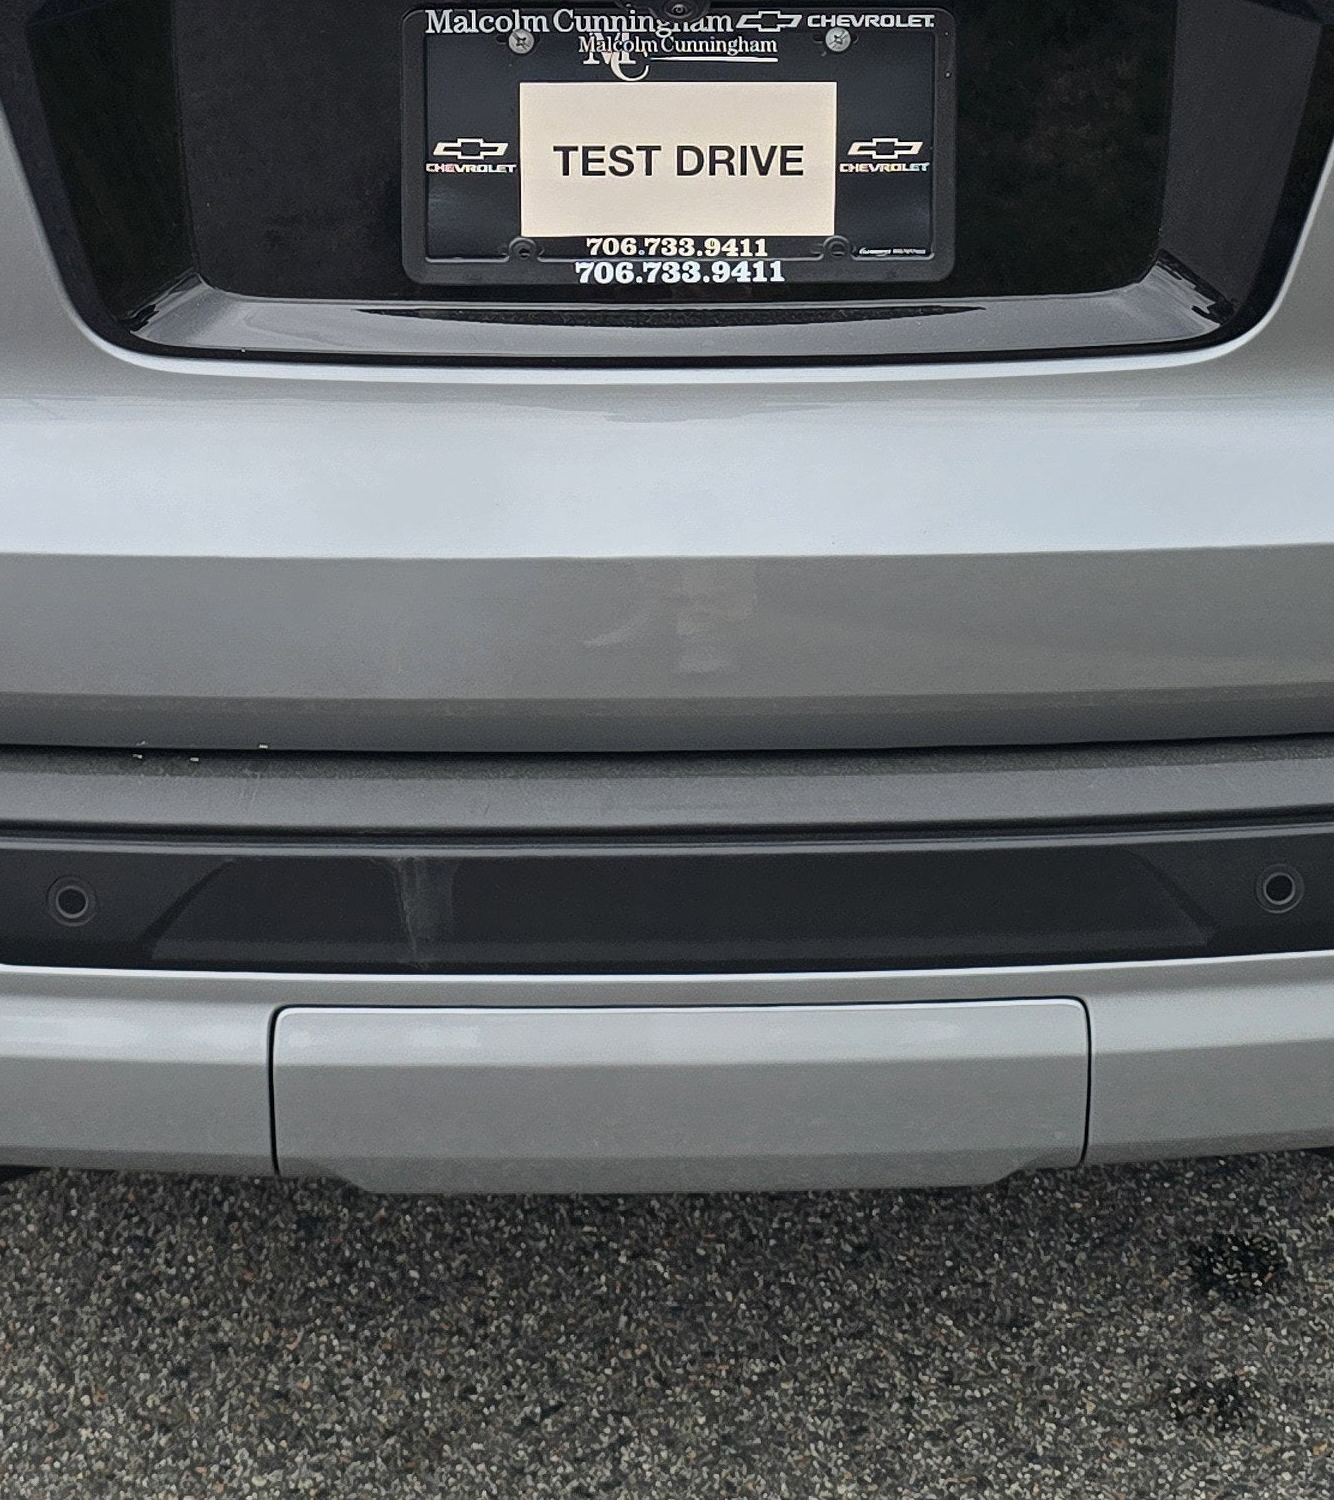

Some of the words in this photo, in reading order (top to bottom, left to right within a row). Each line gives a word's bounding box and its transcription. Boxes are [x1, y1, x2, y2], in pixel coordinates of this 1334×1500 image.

[425, 8, 550, 34] Malcolm
[578, 35, 659, 53] Malcolm
[661, 35, 778, 56] Cunningham
[425, 162, 517, 173] CHEVROLET
[553, 145, 662, 177] TEST
[676, 145, 804, 177] DRIVE
[839, 162, 930, 173] CHEVROLET
[586, 237, 768, 257] 706.733.9411
[575, 261, 785, 284] 706.733.9411
